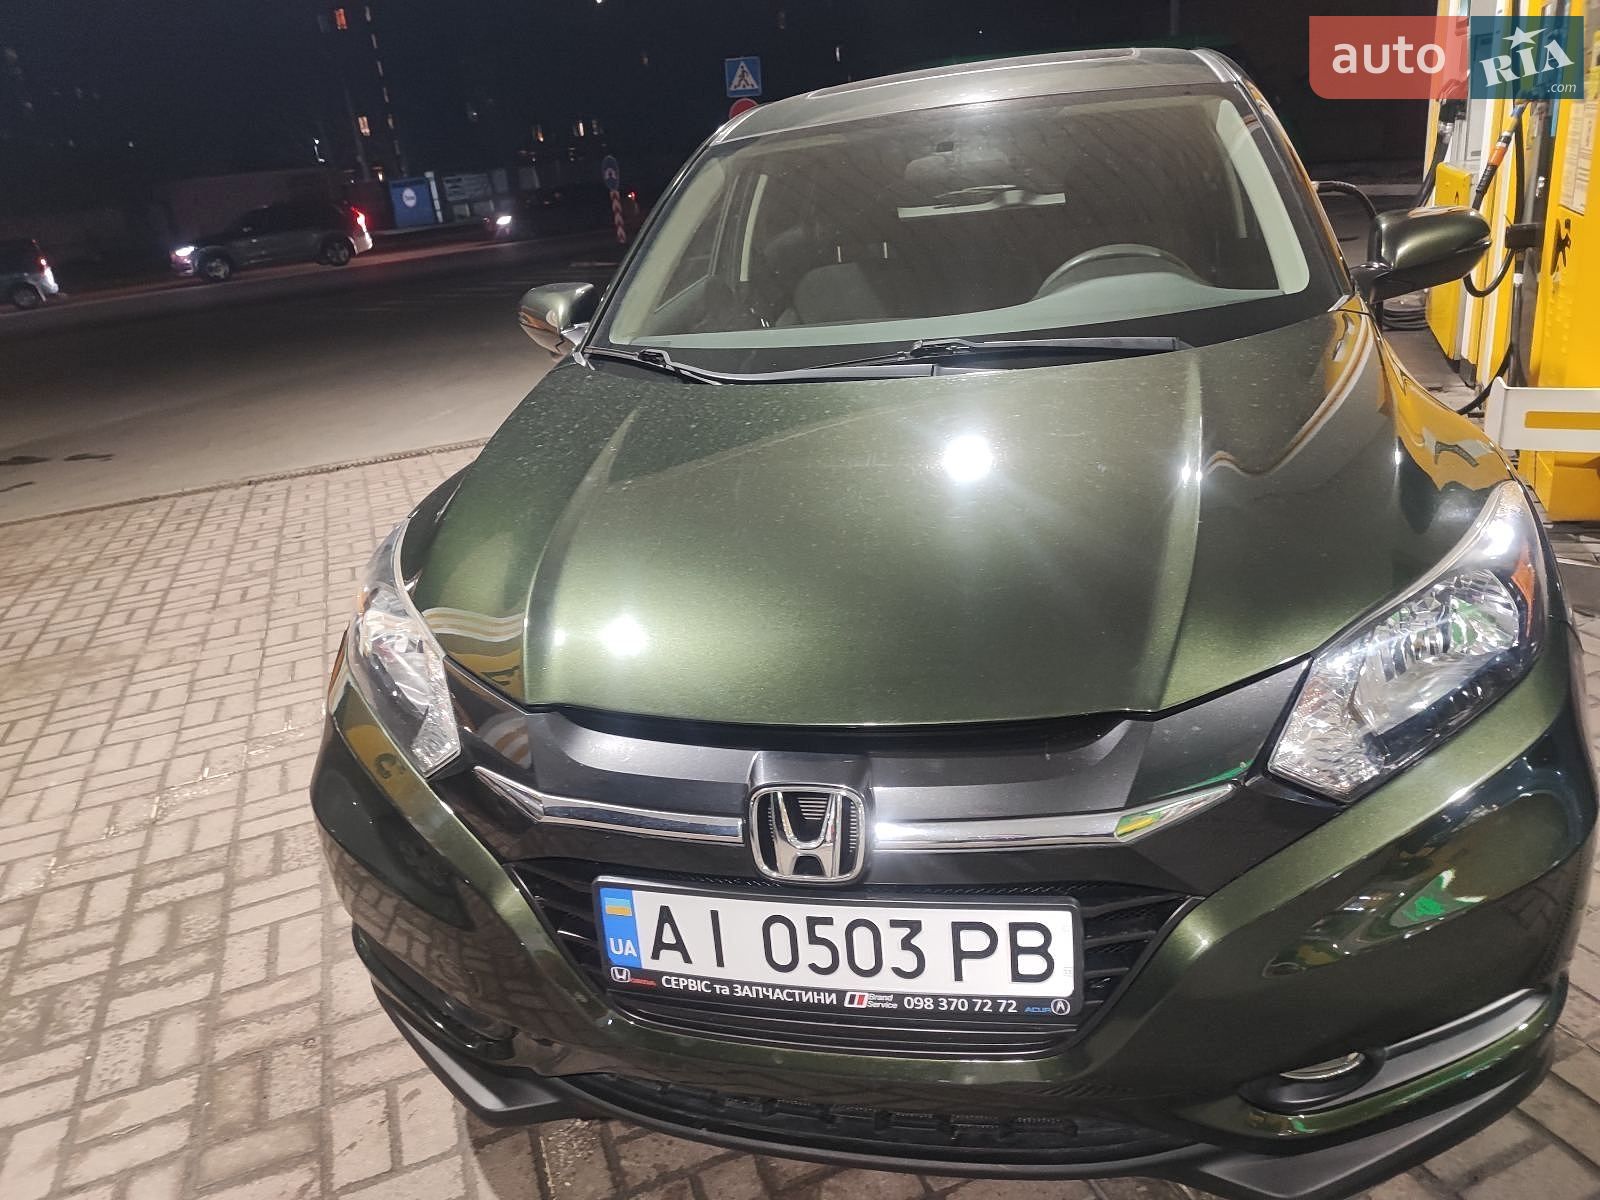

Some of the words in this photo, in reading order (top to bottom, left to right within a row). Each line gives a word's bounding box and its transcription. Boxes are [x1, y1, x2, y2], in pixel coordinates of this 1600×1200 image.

[610, 937, 638, 958] UA
[650, 905, 725, 968] AI
[761, 914, 926, 979] 0503
[951, 921, 1055, 983] PB
[661, 975, 712, 993] СЕРВІС
[713, 984, 730, 996] та
[732, 984, 837, 1005] ЗАПЧАСТИНИ
[869, 993, 894, 1002] Brand
[866, 1000, 898, 1009] Service
[903, 996, 935, 1011] 098
[937, 998, 969, 1012] 370
[973, 999, 993, 1013] 72
[998, 1000, 1018, 1013] 72
